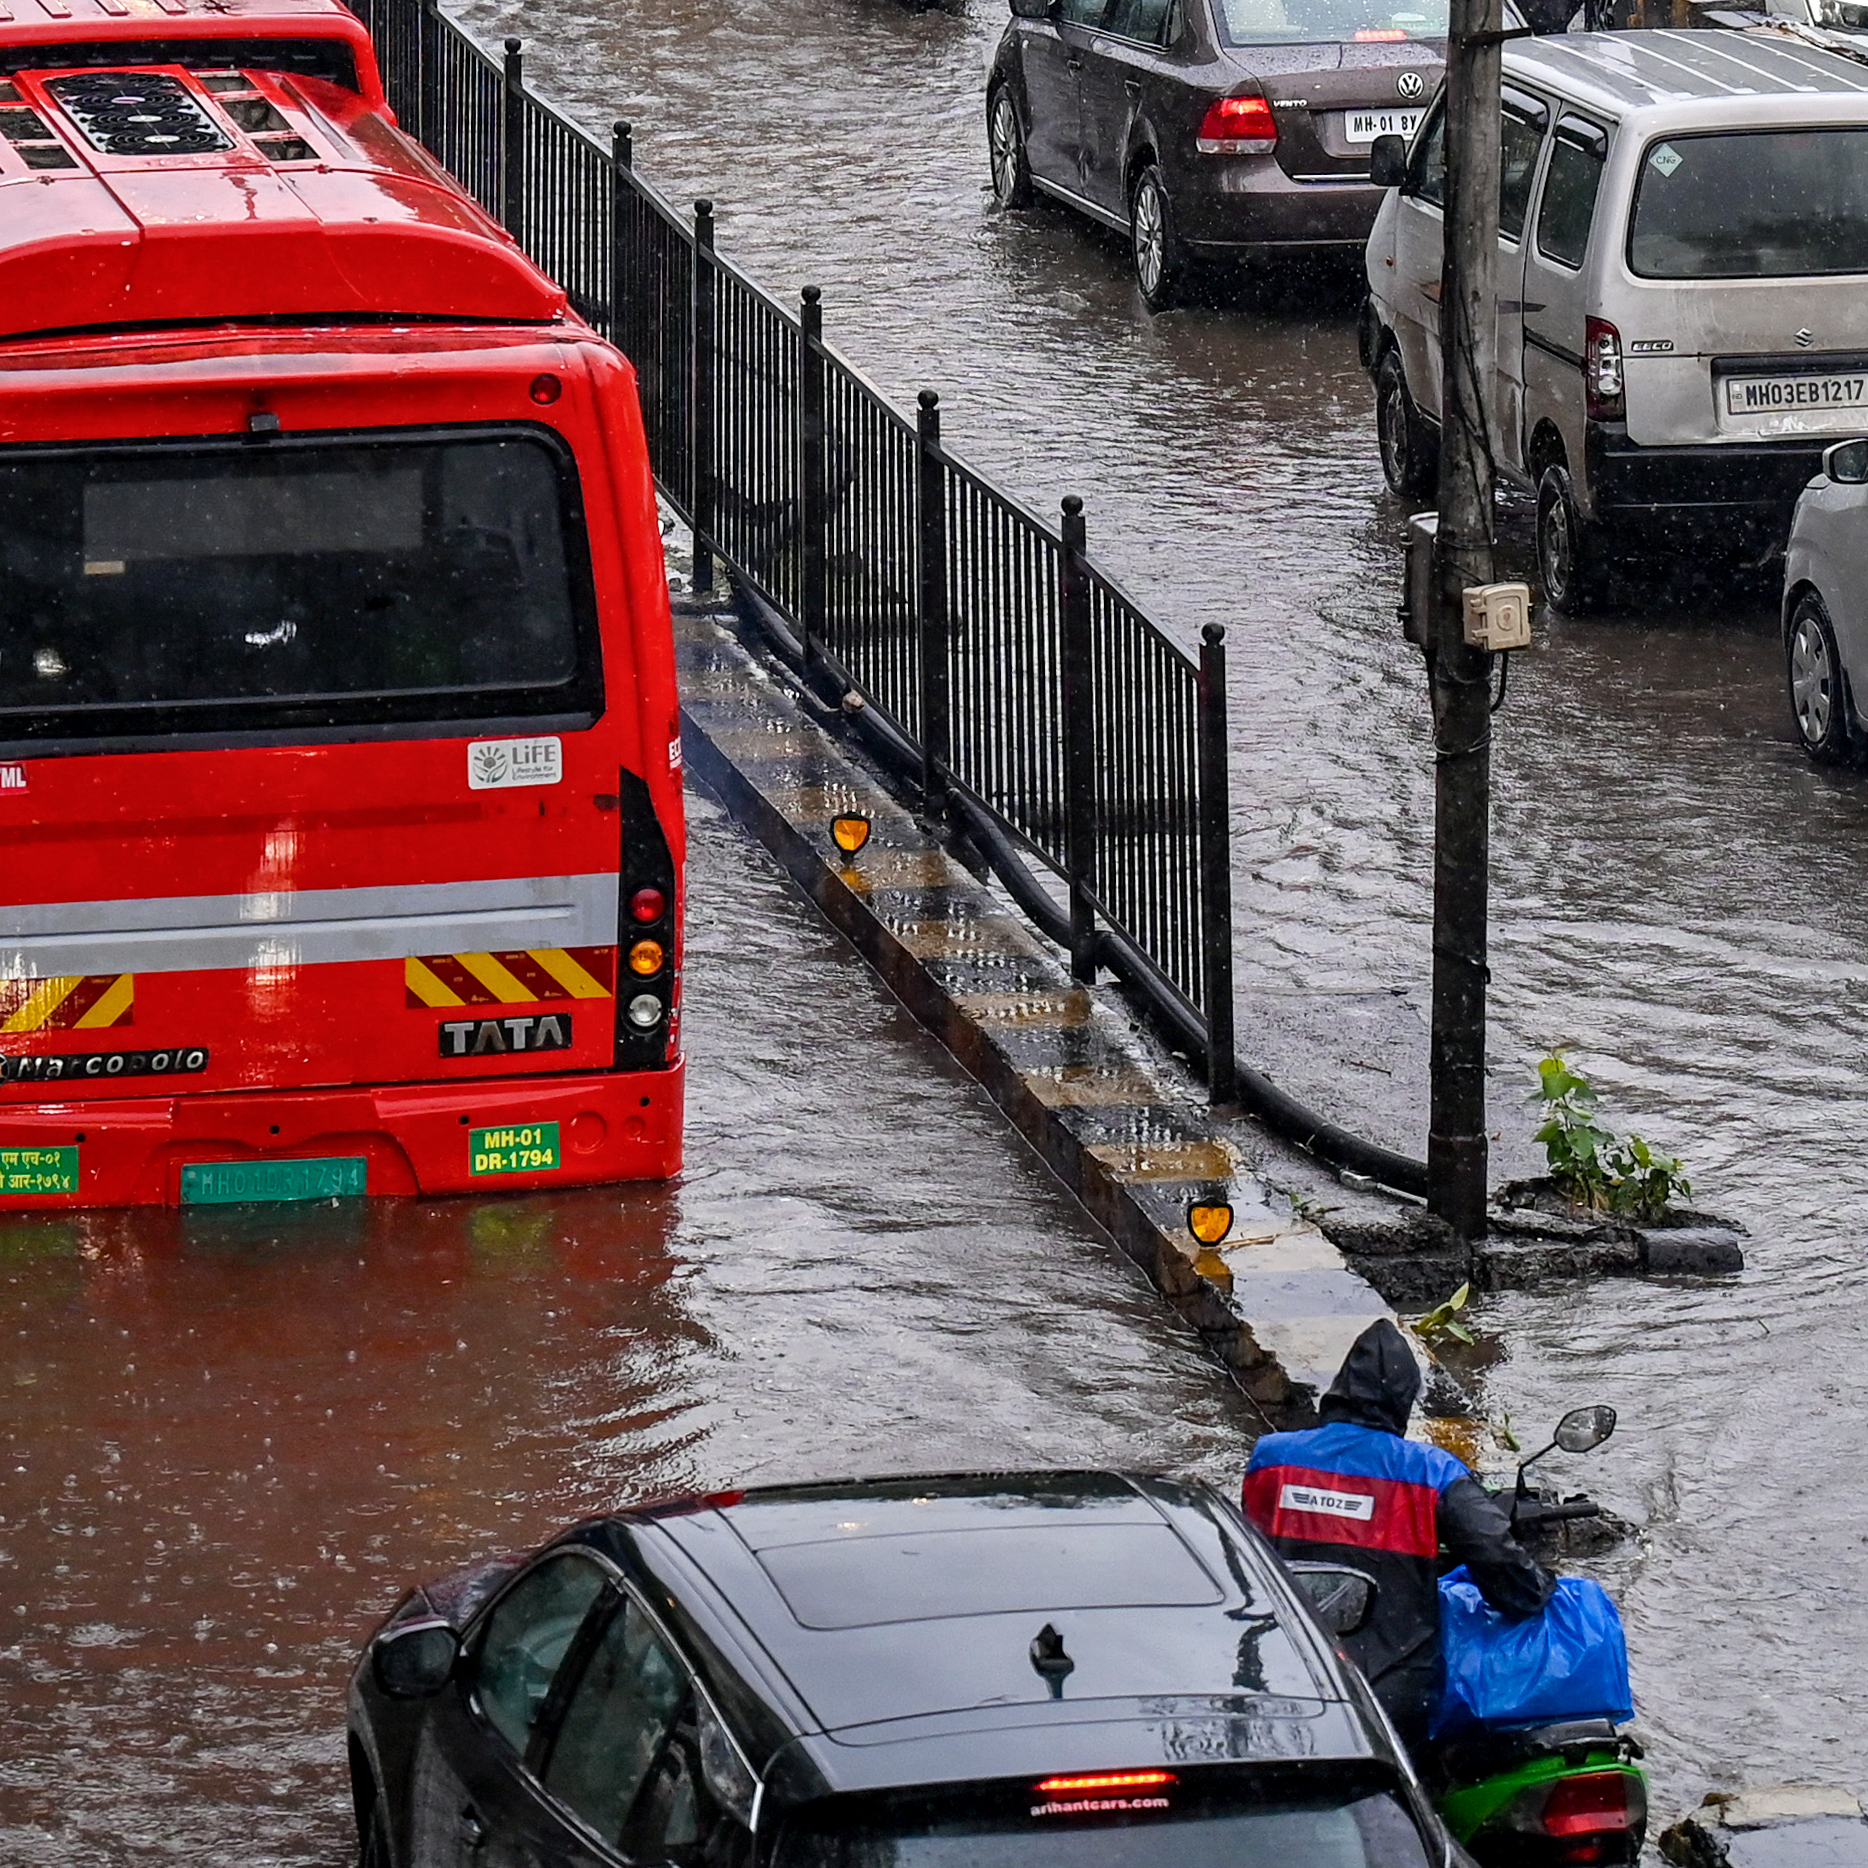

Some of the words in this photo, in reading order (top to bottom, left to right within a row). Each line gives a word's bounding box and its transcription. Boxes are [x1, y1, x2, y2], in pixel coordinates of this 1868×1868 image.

[1273, 99, 1308, 108] VENTO
[1655, 154, 1677, 166] CNG
[1632, 342, 1673, 351] EECO
[1744, 377, 1865, 406] MH03EB1217
[444, 1015, 564, 1054] TATA
[484, 1128, 542, 1149] MH-01
[0, 1152, 19, 1170] एम
[475, 1148, 553, 1171] DR-1794
[1309, 1493, 1344, 1509] ATOZ
[1030, 1795, 1170, 1817] arihantcars.com
